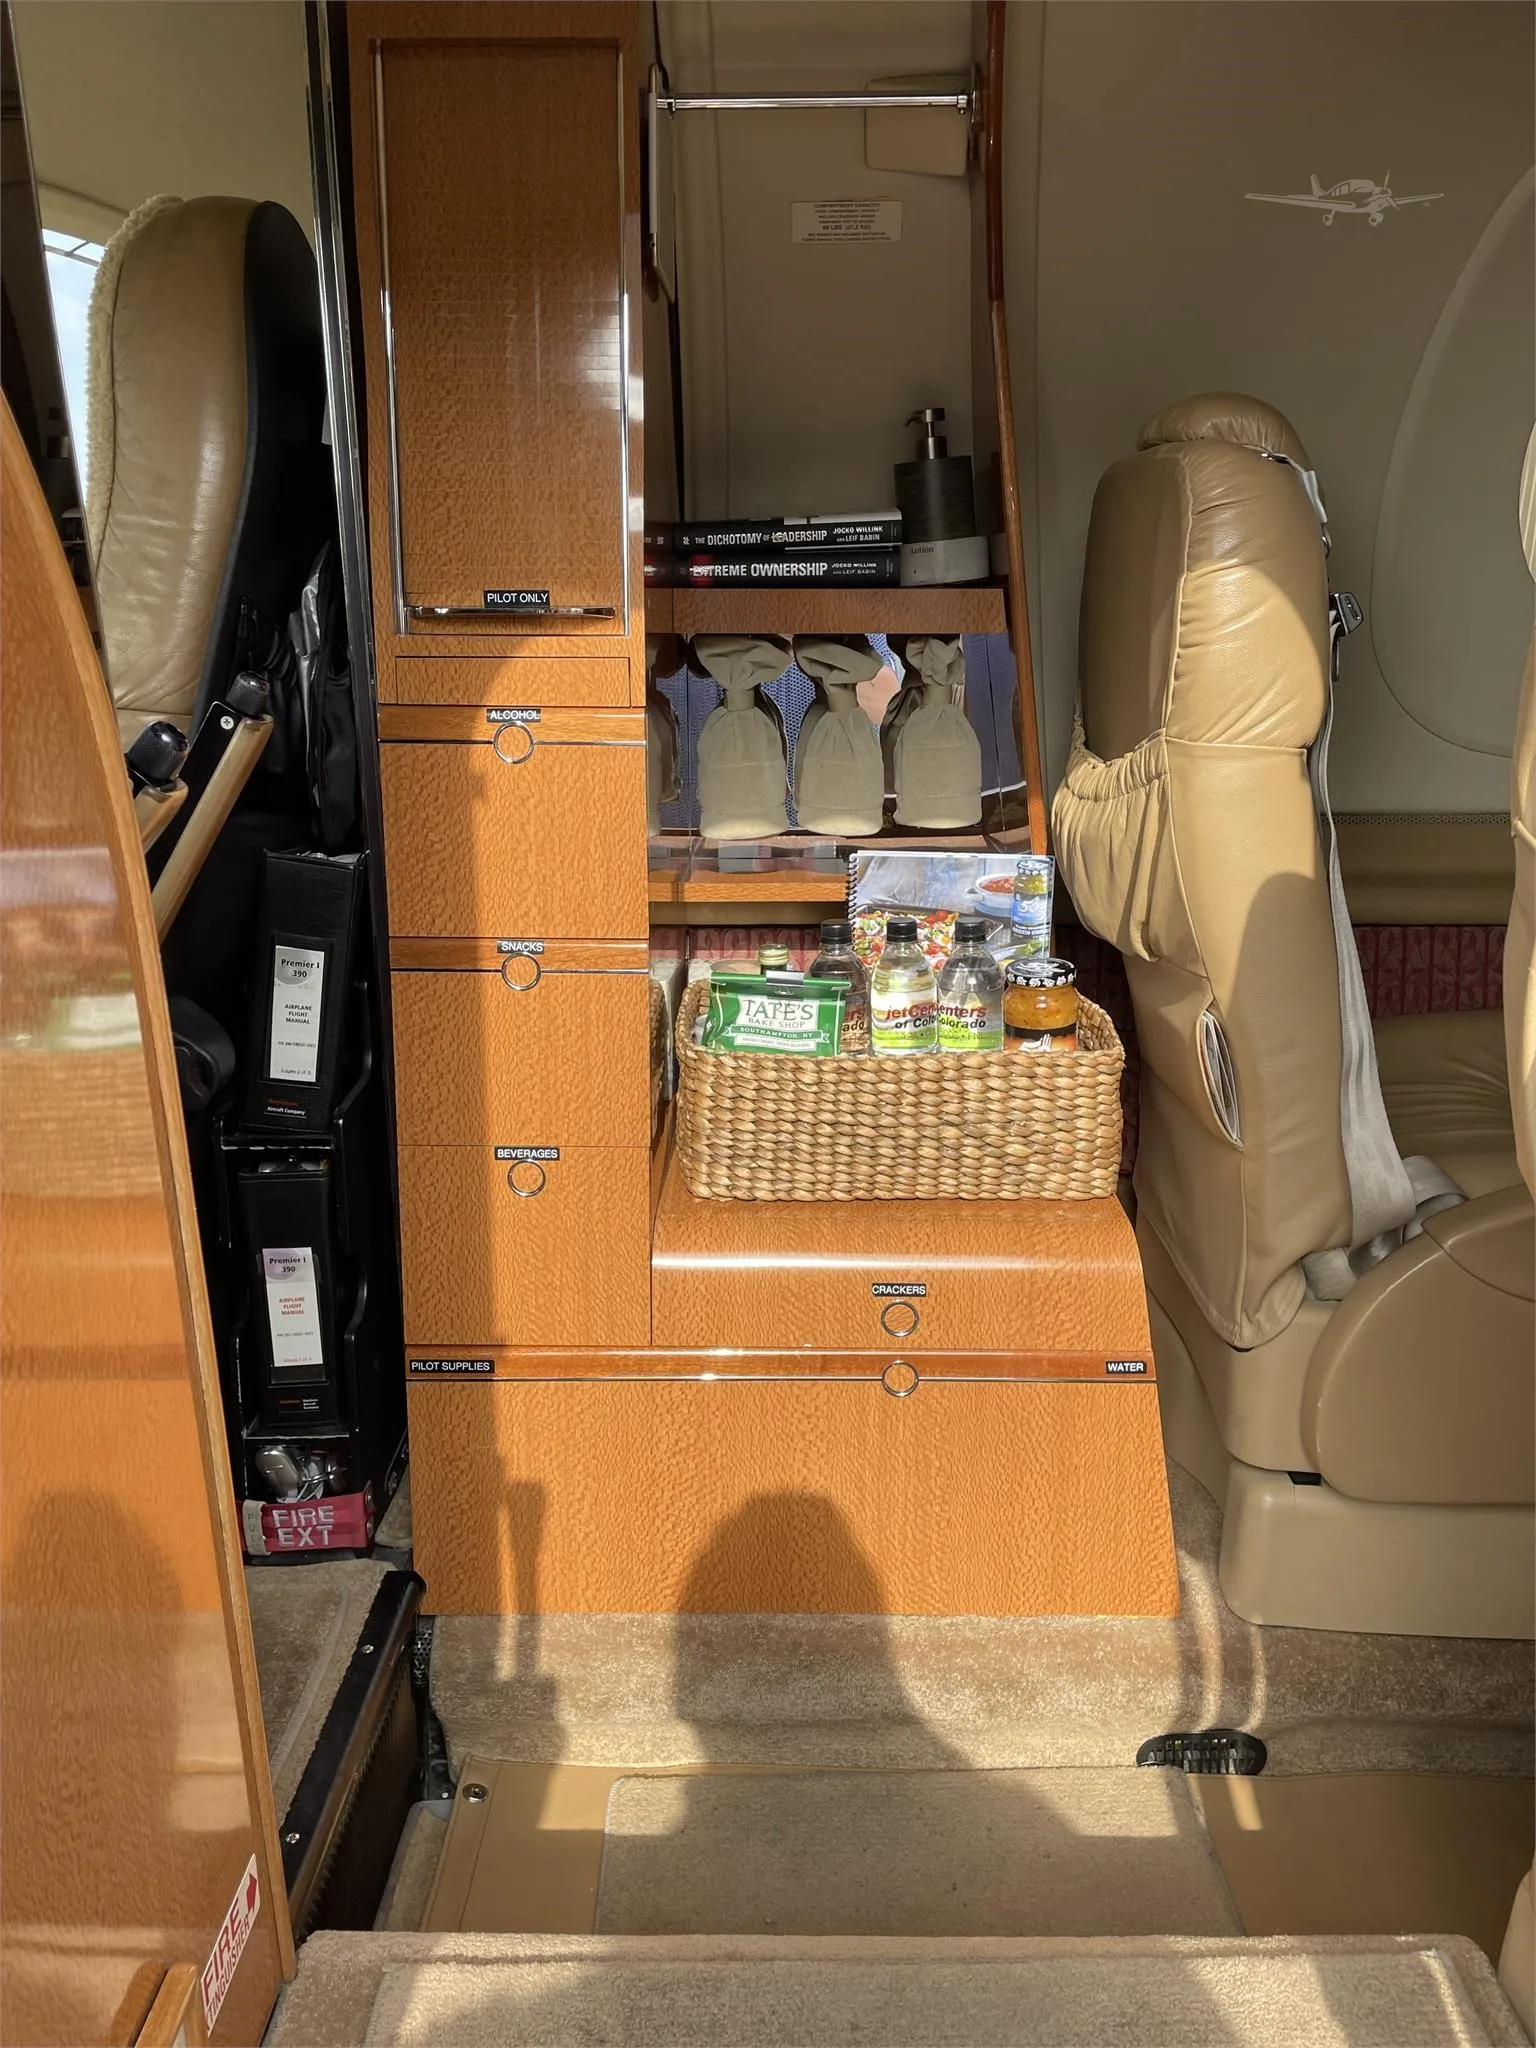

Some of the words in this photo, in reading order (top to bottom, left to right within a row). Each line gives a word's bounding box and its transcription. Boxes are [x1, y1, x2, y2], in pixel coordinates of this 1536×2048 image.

[833, 526, 855, 534] JOCKO
[856, 525, 883, 533] WILLINK
[707, 532, 762, 546] DICHOTOMY
[772, 530, 828, 543] LEADERSHIP
[845, 534, 859, 542] LEIF
[860, 533, 880, 541] BABIN
[693, 564, 747, 577] EXTREME
[751, 562, 828, 577] OWNERSHIP
[487, 592, 516, 603] PILOT
[519, 592, 548, 603] ONLY
[489, 710, 541, 720] ALCOHOL
[501, 941, 544, 952] SNACKS
[281, 958, 314, 969] Premier
[292, 969, 307, 978] 390
[285, 1003, 312, 1011] AIRPLANE
[742, 999, 814, 1021] TATE'S
[748, 1017, 775, 1027] BAKE
[778, 1020, 805, 1029] SHOP
[895, 1019, 910, 1029] of
[284, 1108, 306, 1116] Company
[497, 1148, 558, 1159] BEVERAGES
[269, 1257, 301, 1265] Premier
[872, 1285, 926, 1295] CRACKERS
[411, 1361, 440, 1371] PILOT
[441, 1361, 490, 1371] SUPPLIES
[1107, 1362, 1144, 1372] WATER
[272, 1505, 335, 1528] FIRE
[277, 1525, 333, 1547] EXT
[203, 1896, 242, 2006] FIRE
